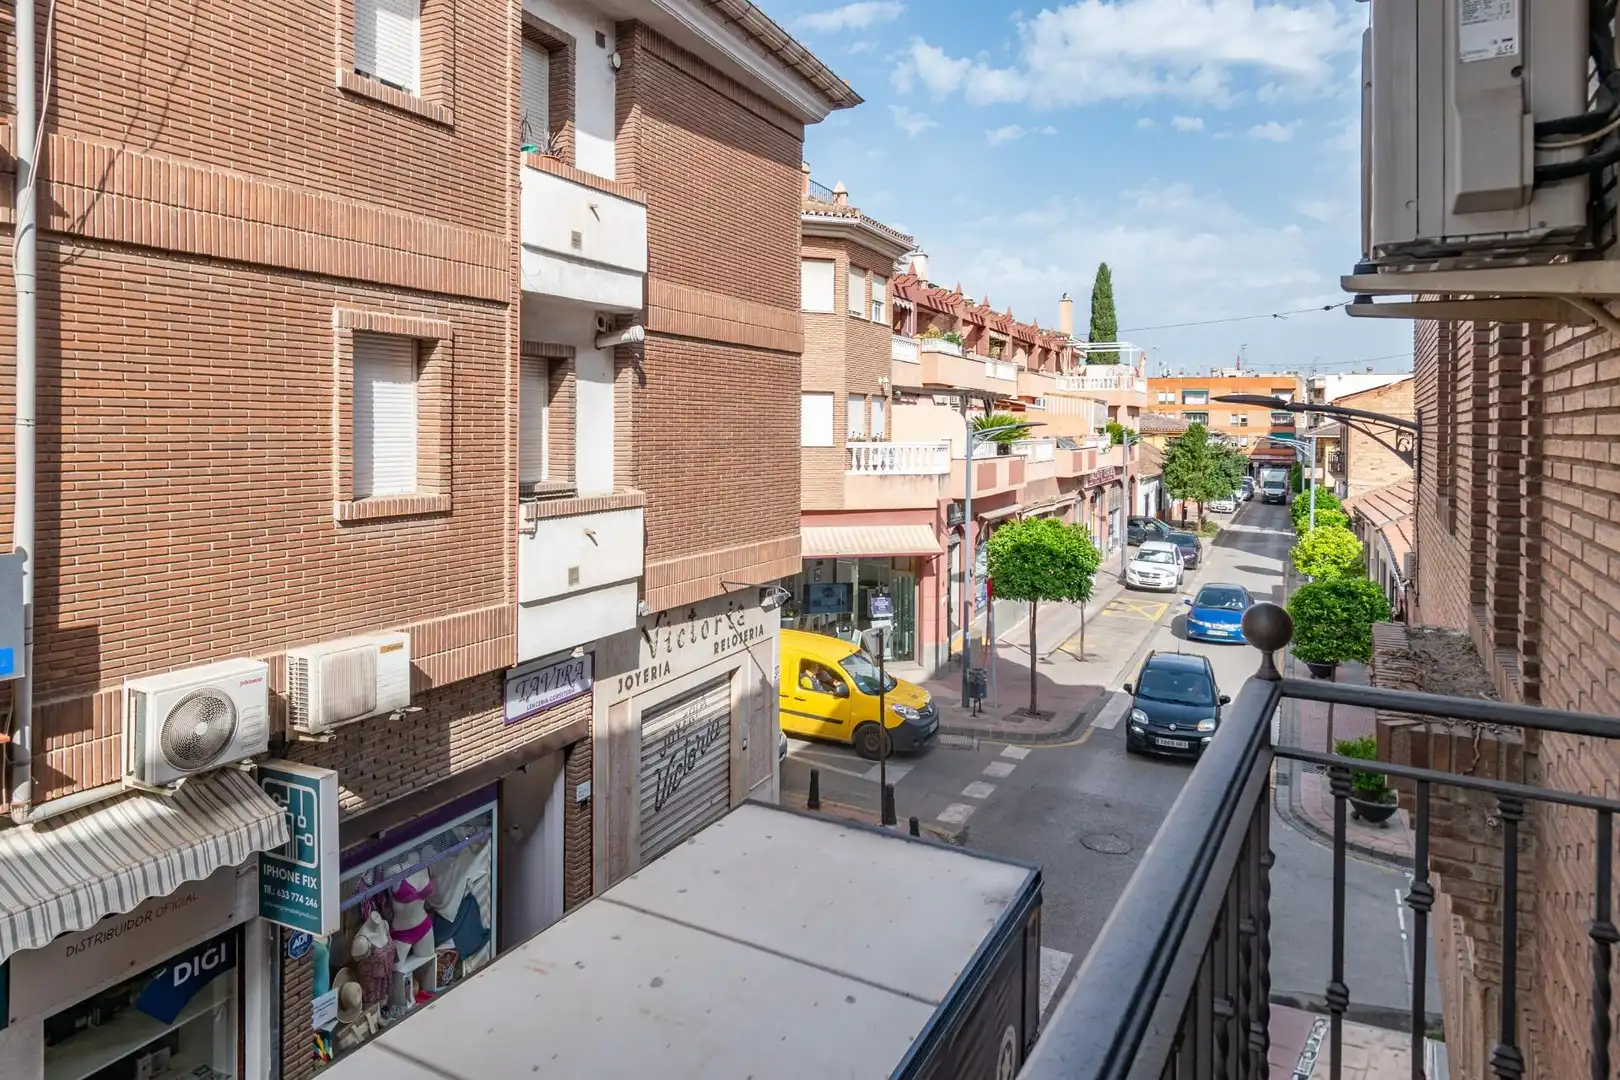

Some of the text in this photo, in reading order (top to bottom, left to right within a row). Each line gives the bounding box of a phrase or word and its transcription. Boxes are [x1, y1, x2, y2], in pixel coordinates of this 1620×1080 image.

[641, 600, 745, 659] Victoria
[713, 623, 765, 655] RELOJERIA
[515, 660, 585, 703] TAVIRA
[617, 660, 671, 694] JOYERIA
[655, 718, 721, 812] Victoria
[263, 863, 318, 890] IPHONE FIX
[276, 888, 290, 900] 633
[291, 891, 304, 904] 774
[304, 896, 319, 909] 246
[65, 891, 199, 958] DISTRIBUIDOR OFICIAL
[173, 942, 226, 988] DIGI
